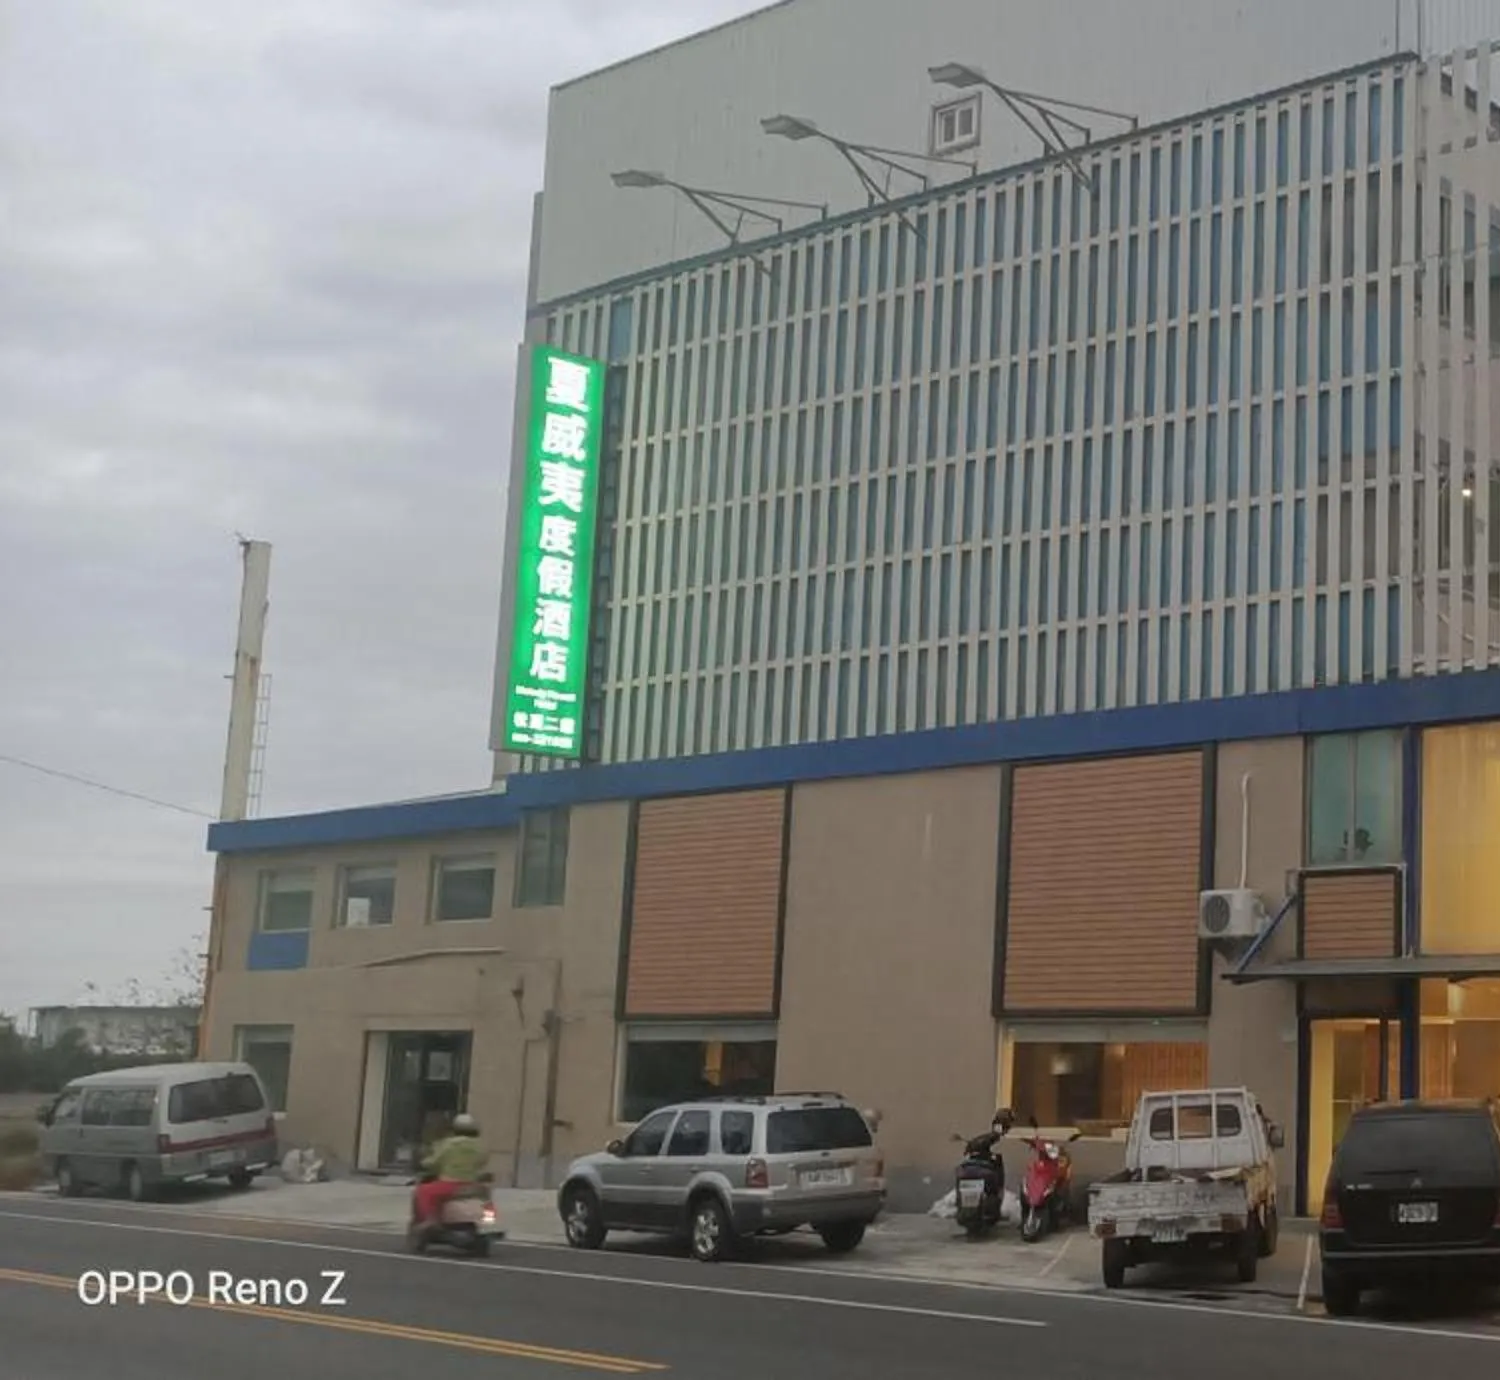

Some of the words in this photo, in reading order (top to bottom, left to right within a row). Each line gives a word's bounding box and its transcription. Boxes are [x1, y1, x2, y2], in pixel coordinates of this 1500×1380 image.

[530, 356, 591, 682] 夏威夷度假酒店
